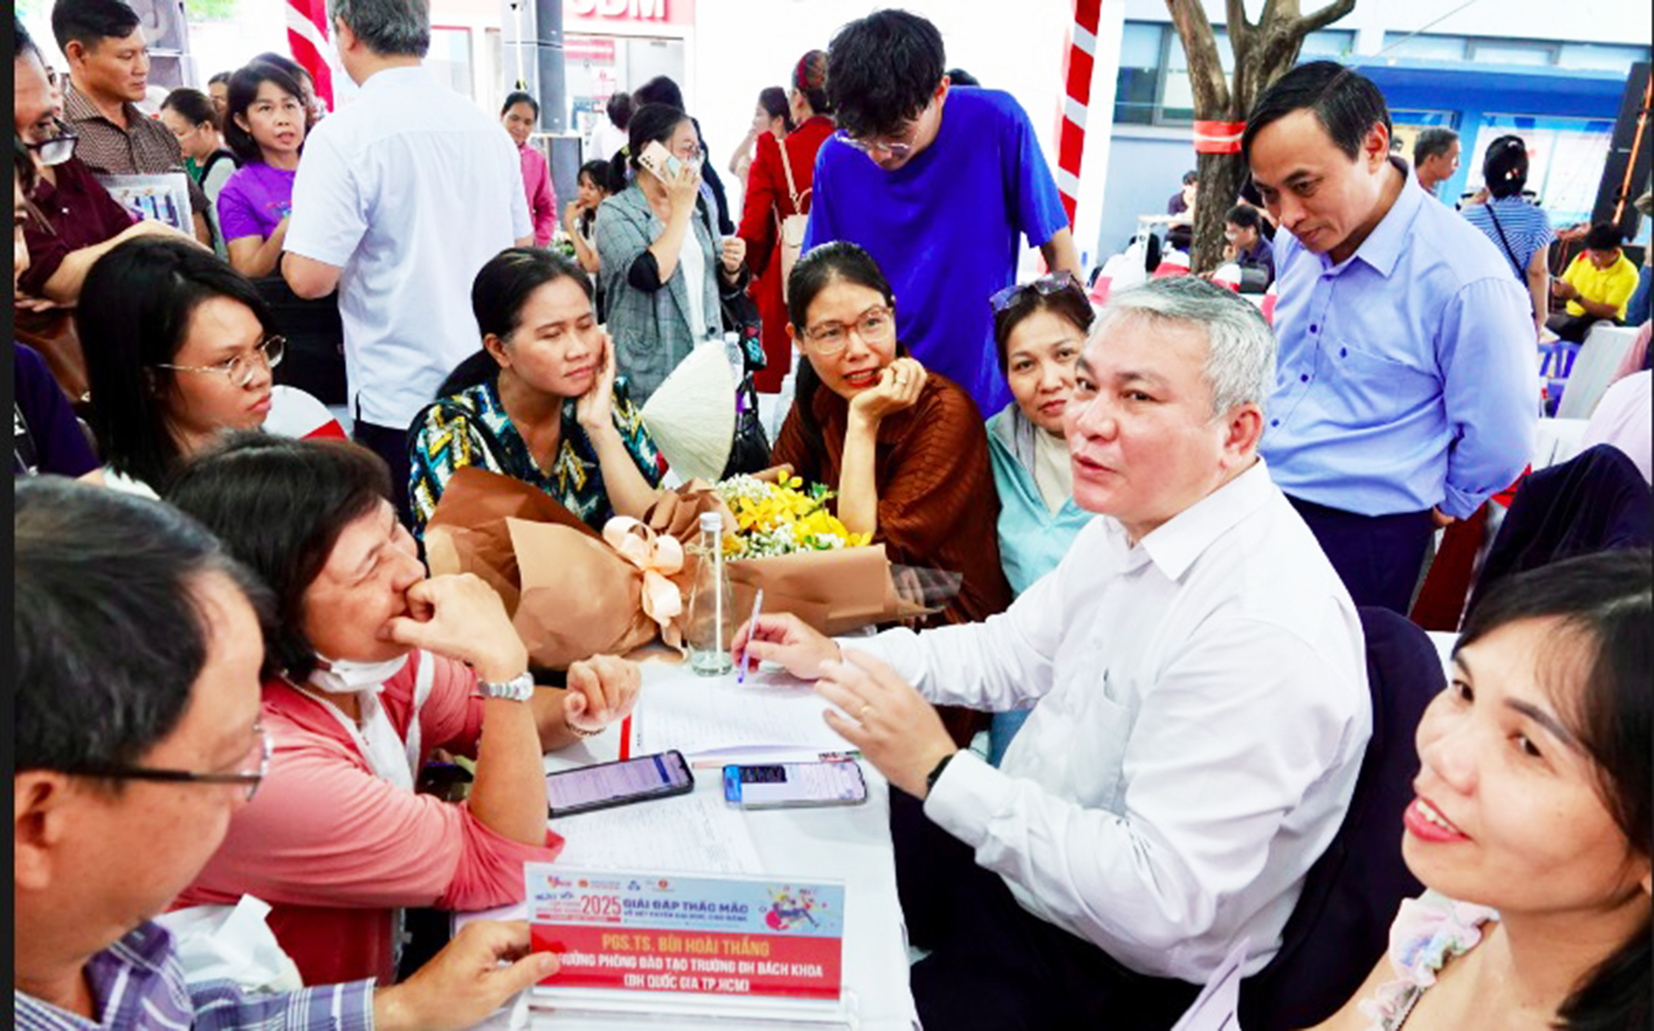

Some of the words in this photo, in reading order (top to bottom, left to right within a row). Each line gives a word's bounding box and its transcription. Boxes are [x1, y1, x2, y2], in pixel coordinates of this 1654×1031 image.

[581, 895, 622, 915] 2025
[623, 898, 650, 909] GIẢI
[602, 933, 655, 951] PGS.TS.
[658, 932, 683, 953] BÙI
[685, 934, 719, 954] HOÀI
[722, 934, 770, 957] THẮNG
[598, 952, 637, 969] PHÒNG
[639, 954, 663, 970] ĐÀO
[665, 957, 688, 972] TẠO
[738, 960, 755, 975] ĐH
[757, 959, 788, 976] BÁCH
[791, 963, 823, 978] KHOA
[624, 973, 644, 987] (ĐH
[647, 971, 677, 988] QUỐC
[679, 975, 699, 990] GIA
[701, 977, 750, 992] TP.HCM)
